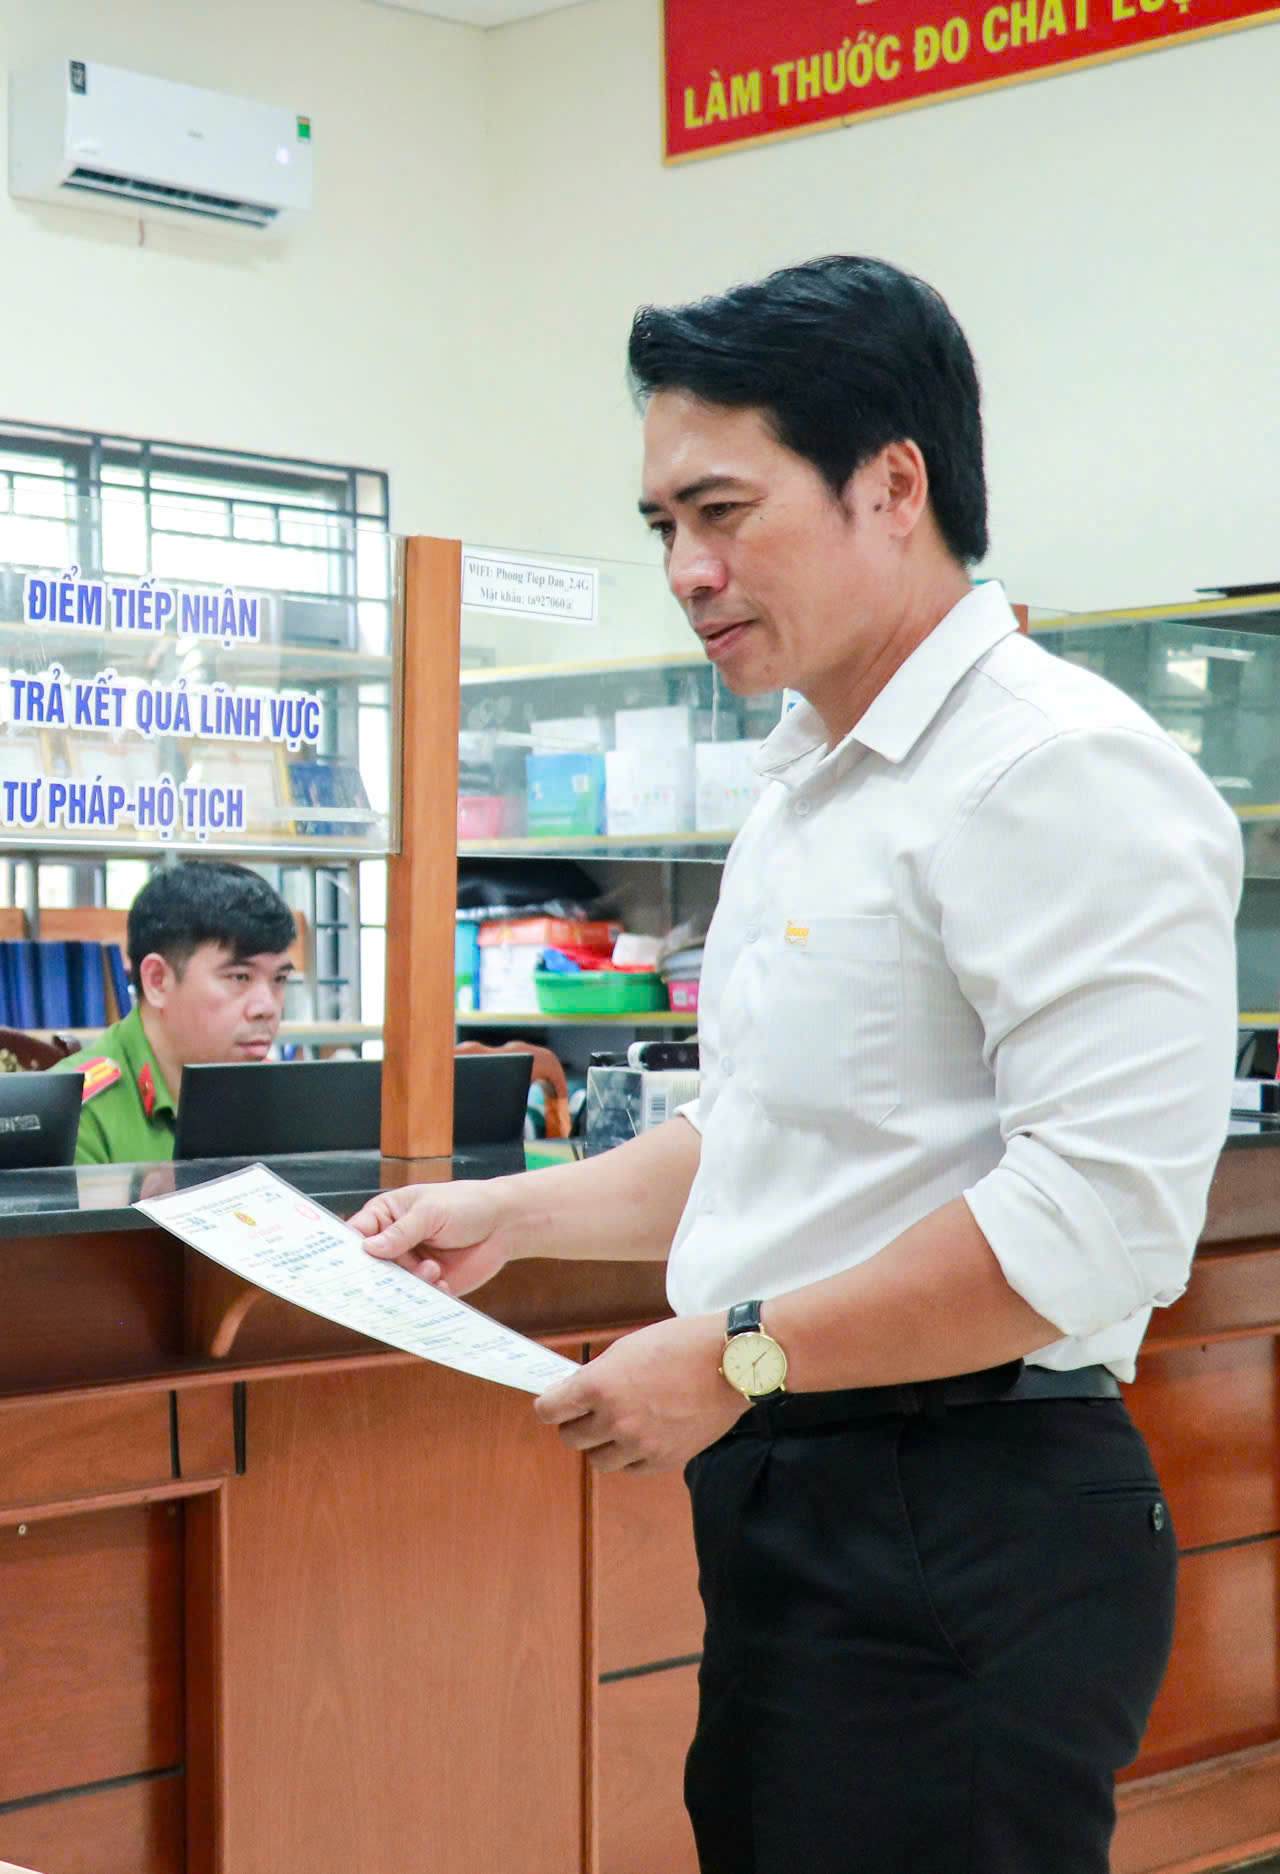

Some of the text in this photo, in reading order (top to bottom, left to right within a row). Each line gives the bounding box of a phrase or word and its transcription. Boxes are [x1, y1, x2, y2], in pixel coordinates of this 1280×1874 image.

[684, 69, 761, 129] LÀM
[772, 30, 901, 107] THƯỚC
[914, 17, 969, 71] ĐO
[28, 565, 258, 648] ĐIỂM TIẾP NHẬN
[9, 668, 66, 724] TRẢ
[74, 674, 128, 729] KẾT
[135, 677, 192, 735] QUẢ
[200, 686, 261, 738] LĨNH
[269, 698, 321, 749] VỰC
[3, 778, 42, 823] TƯ
[183, 787, 244, 839] TỊCH
